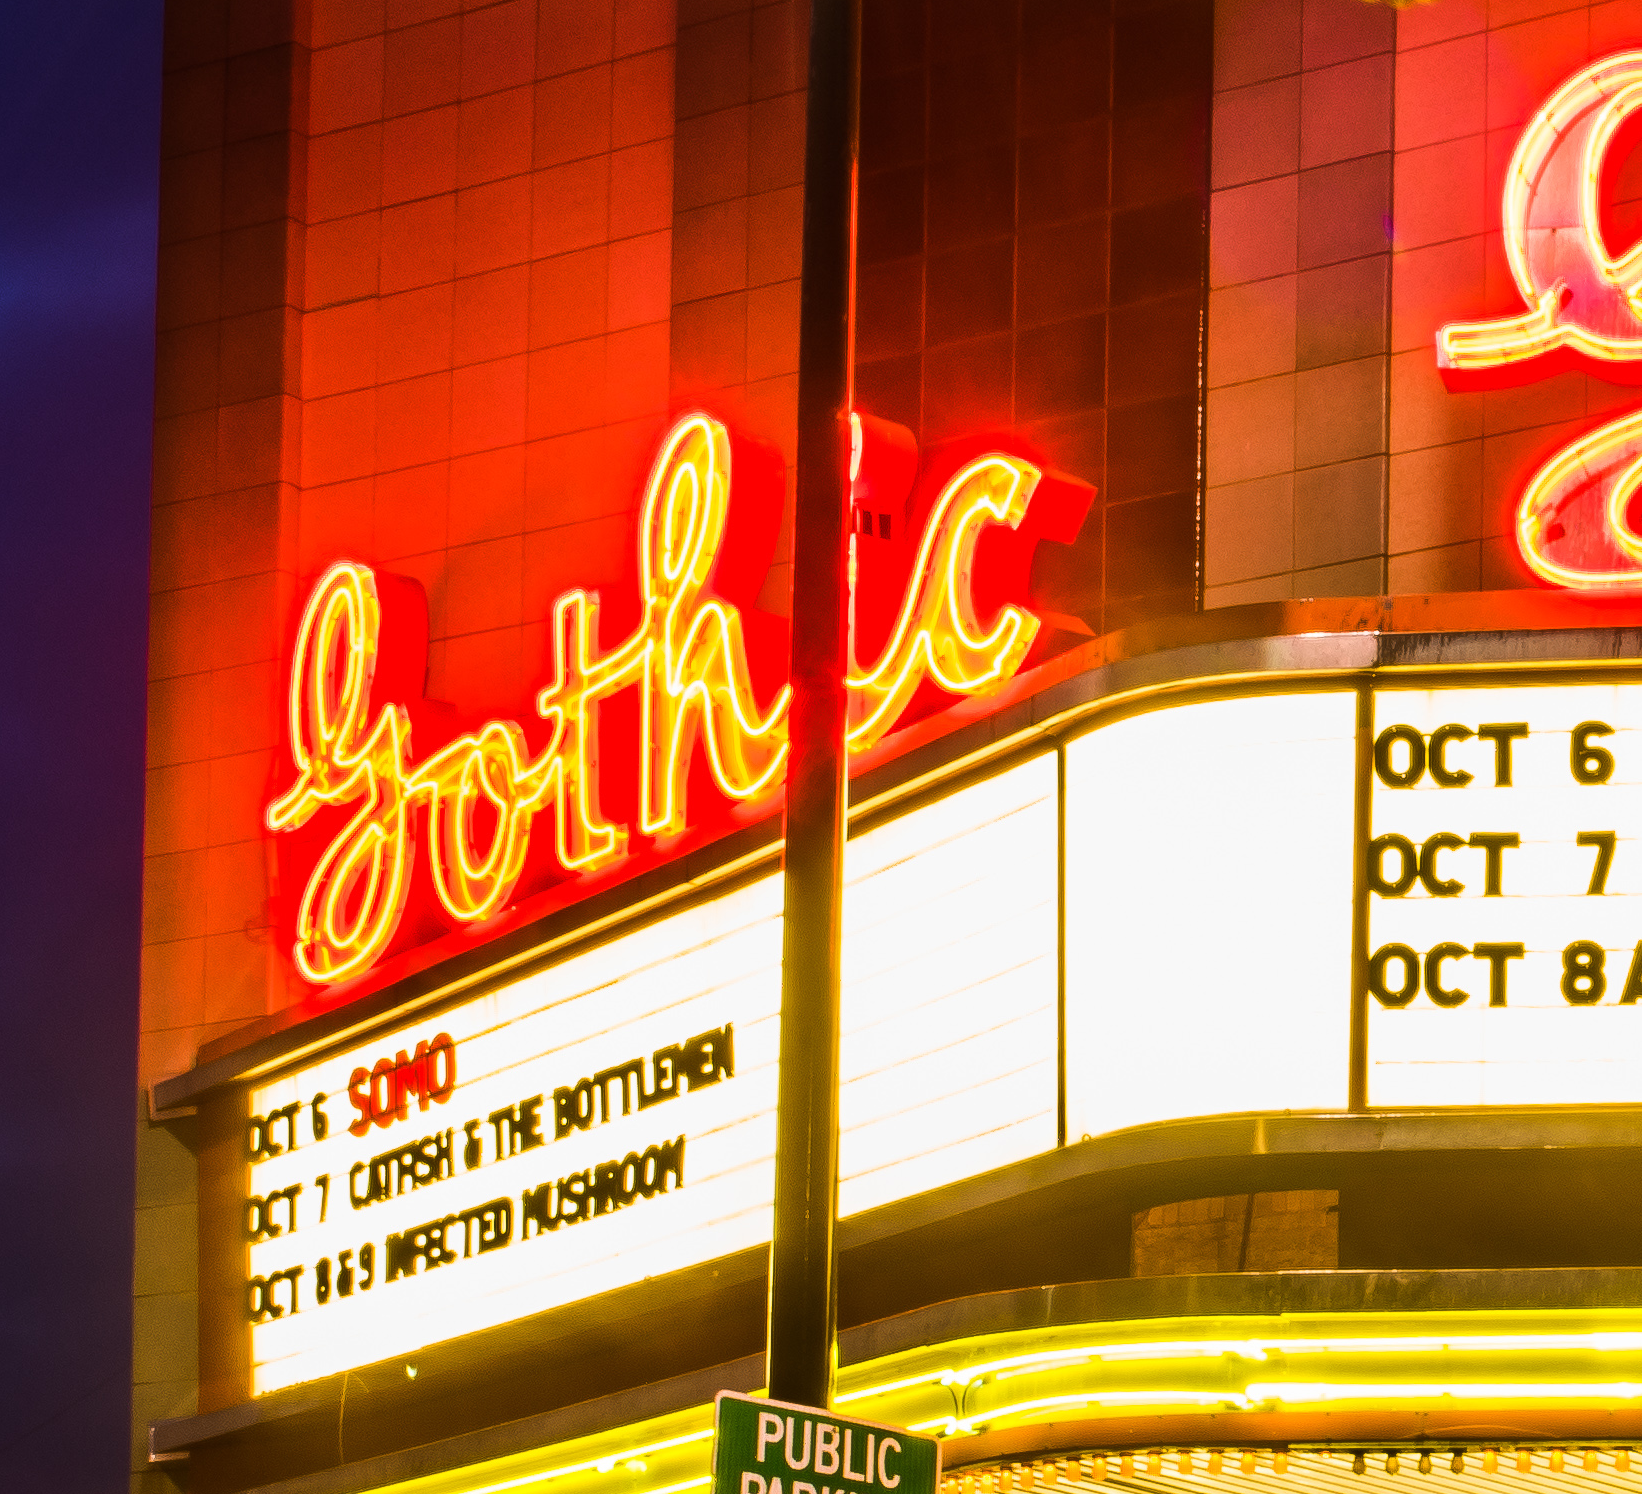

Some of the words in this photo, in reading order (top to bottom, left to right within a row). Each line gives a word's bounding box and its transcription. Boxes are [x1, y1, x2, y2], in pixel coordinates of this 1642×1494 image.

[266, 411, 1042, 985] Gothc
[1374, 721, 1529, 789] OCT
[1569, 719, 1615, 786] 6
[1366, 831, 1522, 898] OCT
[1577, 829, 1617, 896] 7
[1367, 941, 1525, 1009] OCT
[1560, 938, 1607, 1006] 8
[246, 1182, 303, 1242] OCT
[314, 1173, 330, 1224] 7
[463, 1117, 483, 1171] &
[488, 1093, 545, 1162] THE
[553, 1021, 736, 1141] BOTTLEMEN
[247, 1100, 302, 1162] OCT
[311, 1091, 329, 1142] 6
[348, 1031, 456, 1138] SOMO
[247, 1263, 304, 1323] OCT
[385, 1196, 514, 1284] INFECTED
[521, 1133, 686, 1242] MUSHROOM
[756, 1411, 902, 1490] PUBLIC
